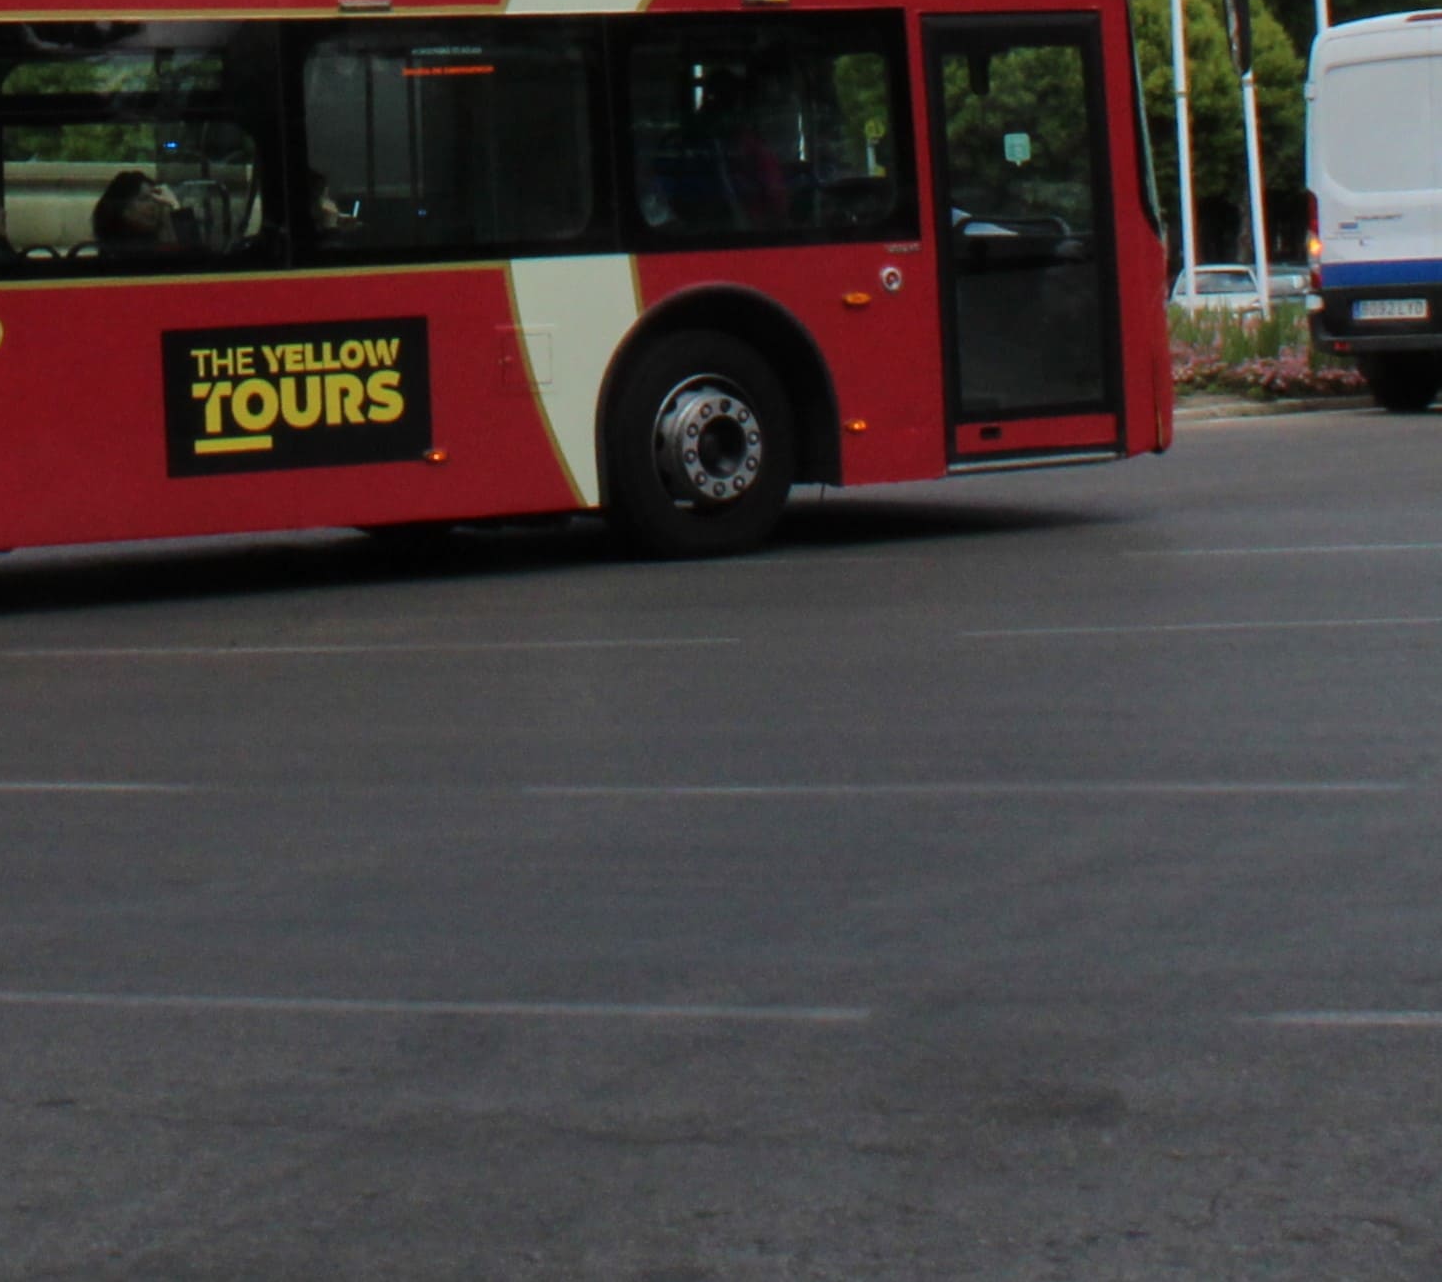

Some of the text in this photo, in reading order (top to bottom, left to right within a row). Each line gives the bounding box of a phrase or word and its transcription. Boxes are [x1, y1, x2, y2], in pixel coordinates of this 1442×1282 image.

[191, 337, 401, 378] THE YELLOW
[191, 369, 405, 435] TOURS
